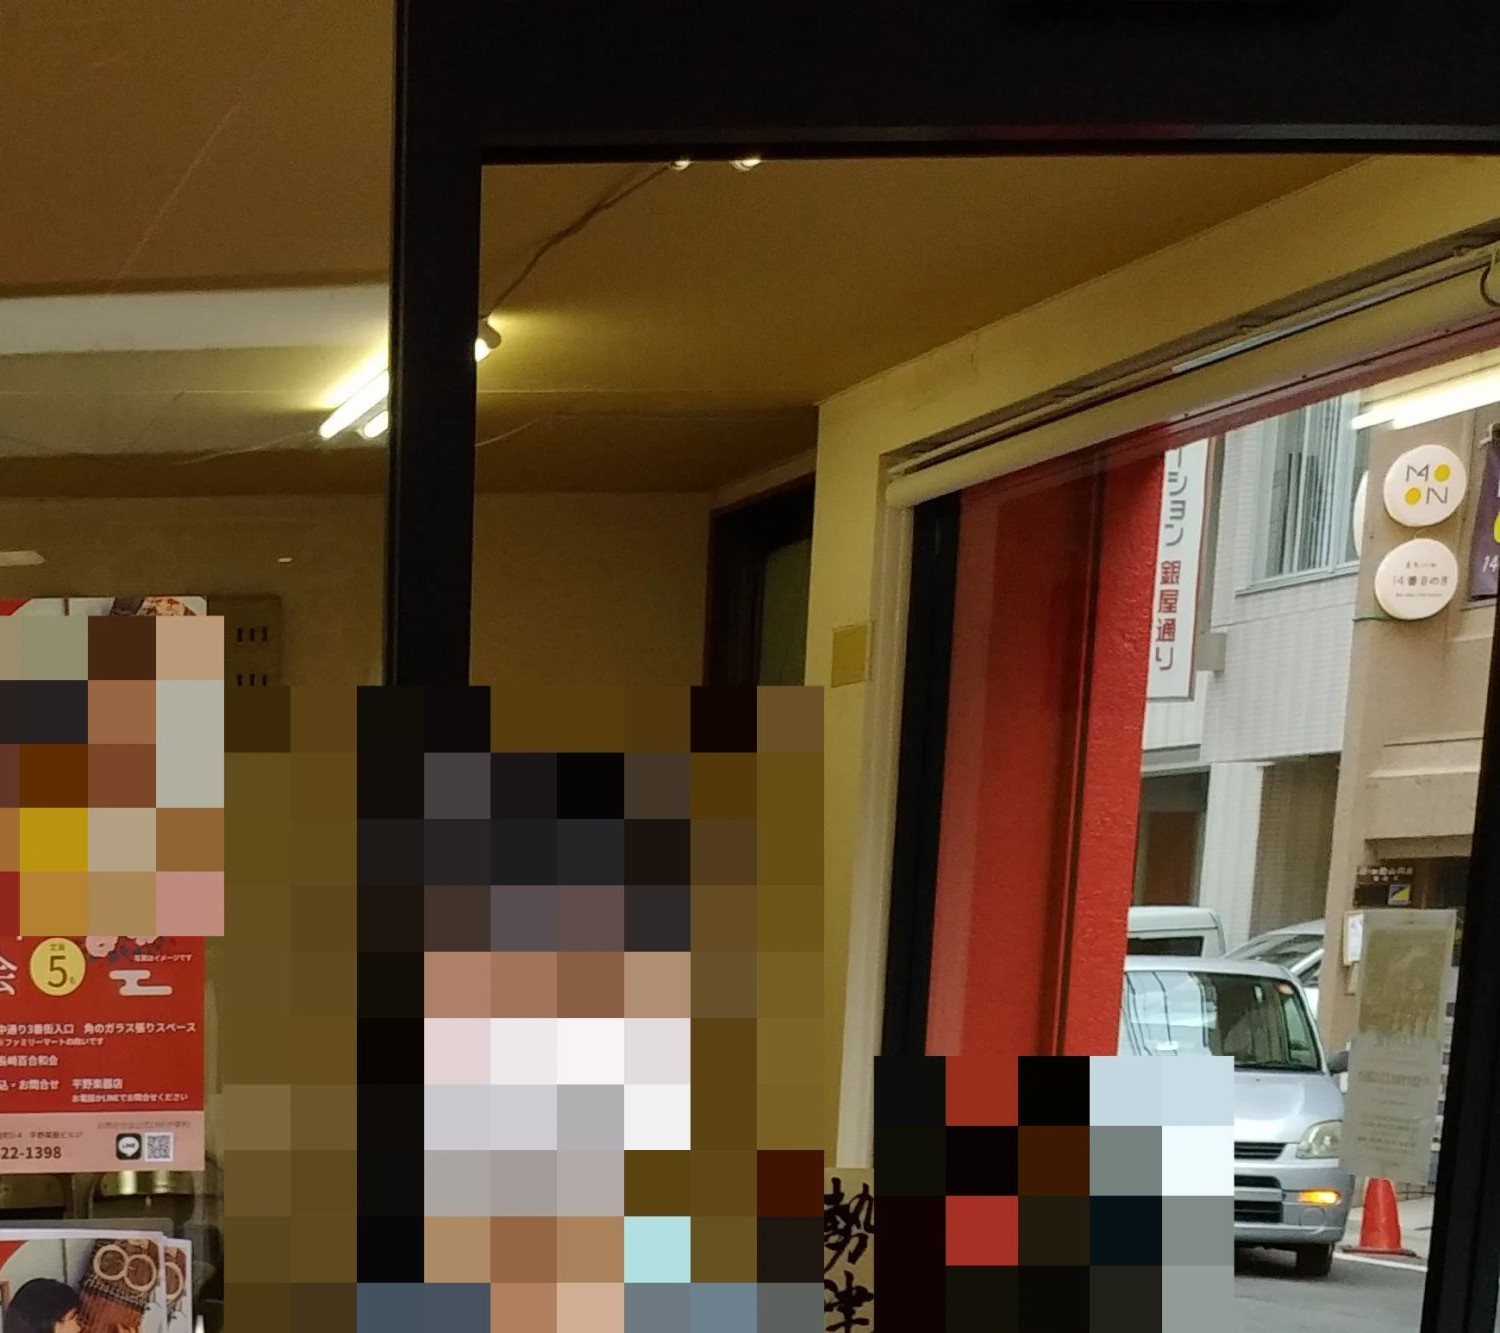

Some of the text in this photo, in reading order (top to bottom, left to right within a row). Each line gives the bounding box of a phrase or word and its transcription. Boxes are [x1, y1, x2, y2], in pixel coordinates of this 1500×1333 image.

[1155, 560, 1182, 671] 銀屋通り
[46, 955, 67, 988] 5
